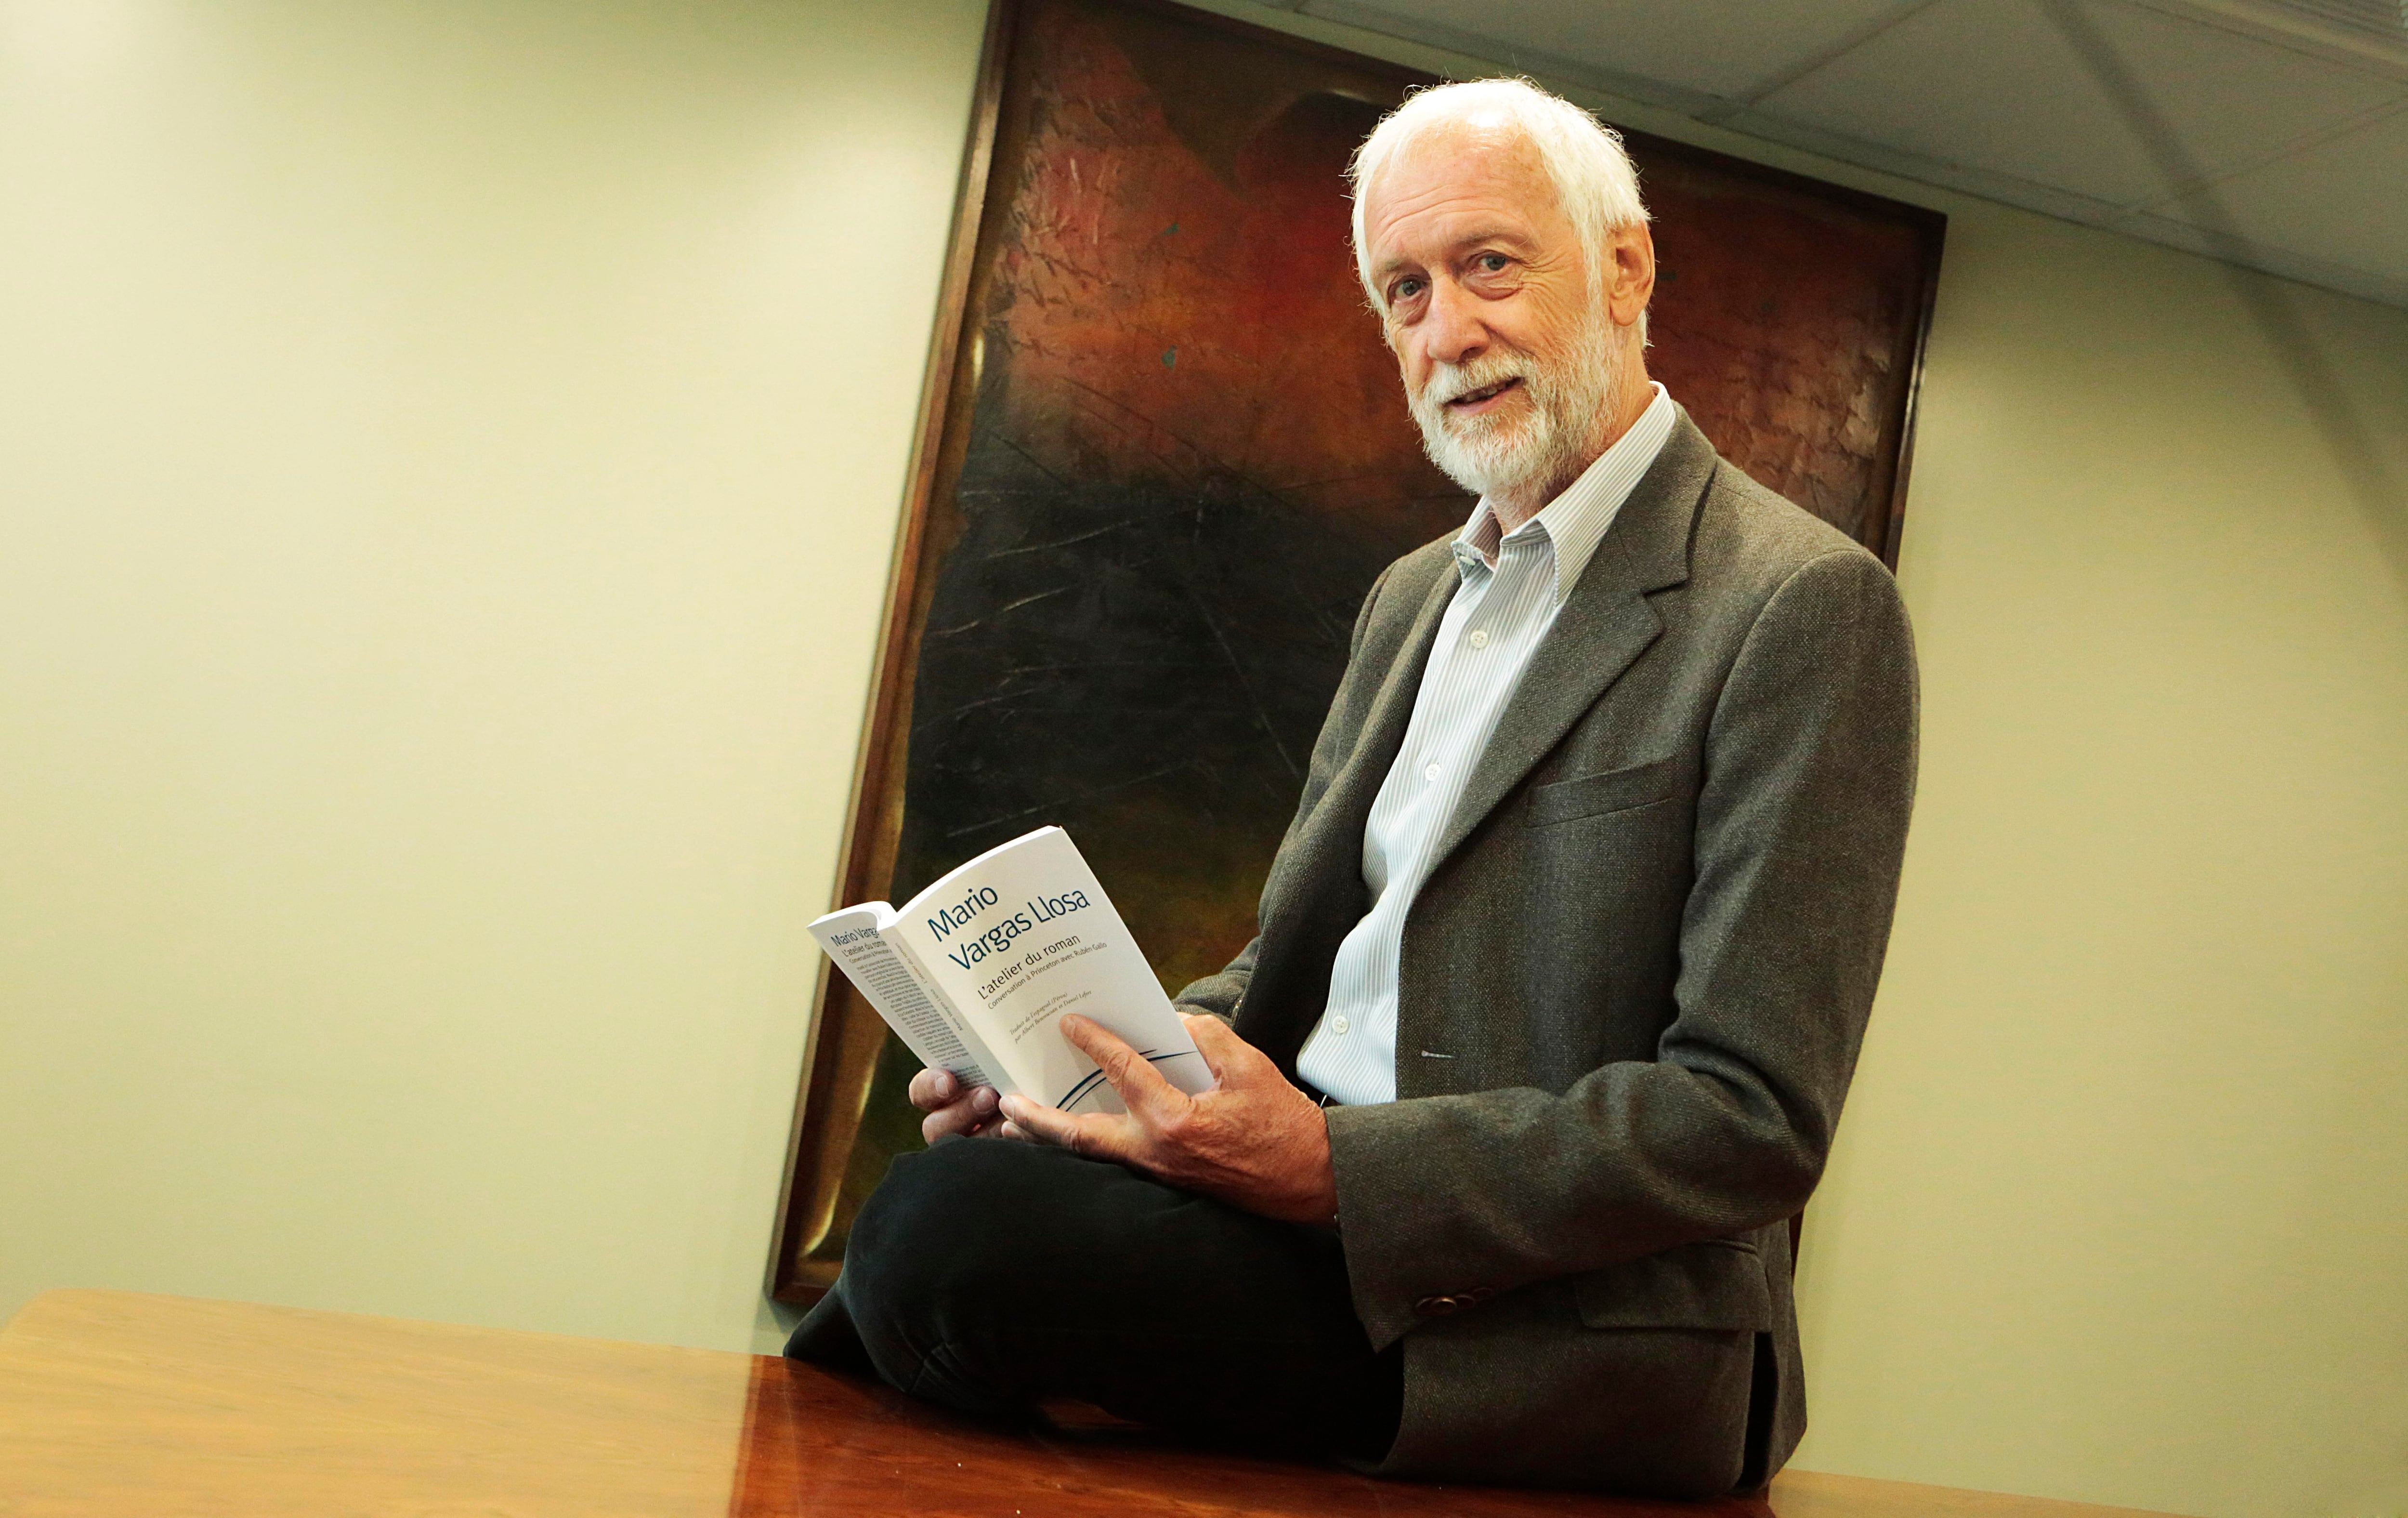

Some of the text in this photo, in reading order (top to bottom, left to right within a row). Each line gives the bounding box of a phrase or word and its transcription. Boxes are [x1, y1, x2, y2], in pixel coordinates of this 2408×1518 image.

[831, 931, 858, 947] Mario
[927, 886, 998, 942] Mario
[948, 890, 1090, 971] Vargas Llosa
[841, 945, 865, 957] L'atelier
[978, 934, 1081, 1000] L'atelier du roman
[988, 978, 1026, 1010] Conversation
[1031, 960, 1060, 977] Princeton
[1060, 953, 1075, 963] avec
[1074, 946, 1093, 957] Rubén
[1092, 942, 1107, 950] Gallo
[1009, 1020, 1025, 1035] Traduit
[1051, 992, 1068, 1004] (Pérou)
[1021, 1023, 1035, 1036] Albert
[1034, 1007, 1058, 1024] Bensoussan
[1063, 996, 1079, 1006] Daniel
[1078, 990, 1092, 1001] Lefort
